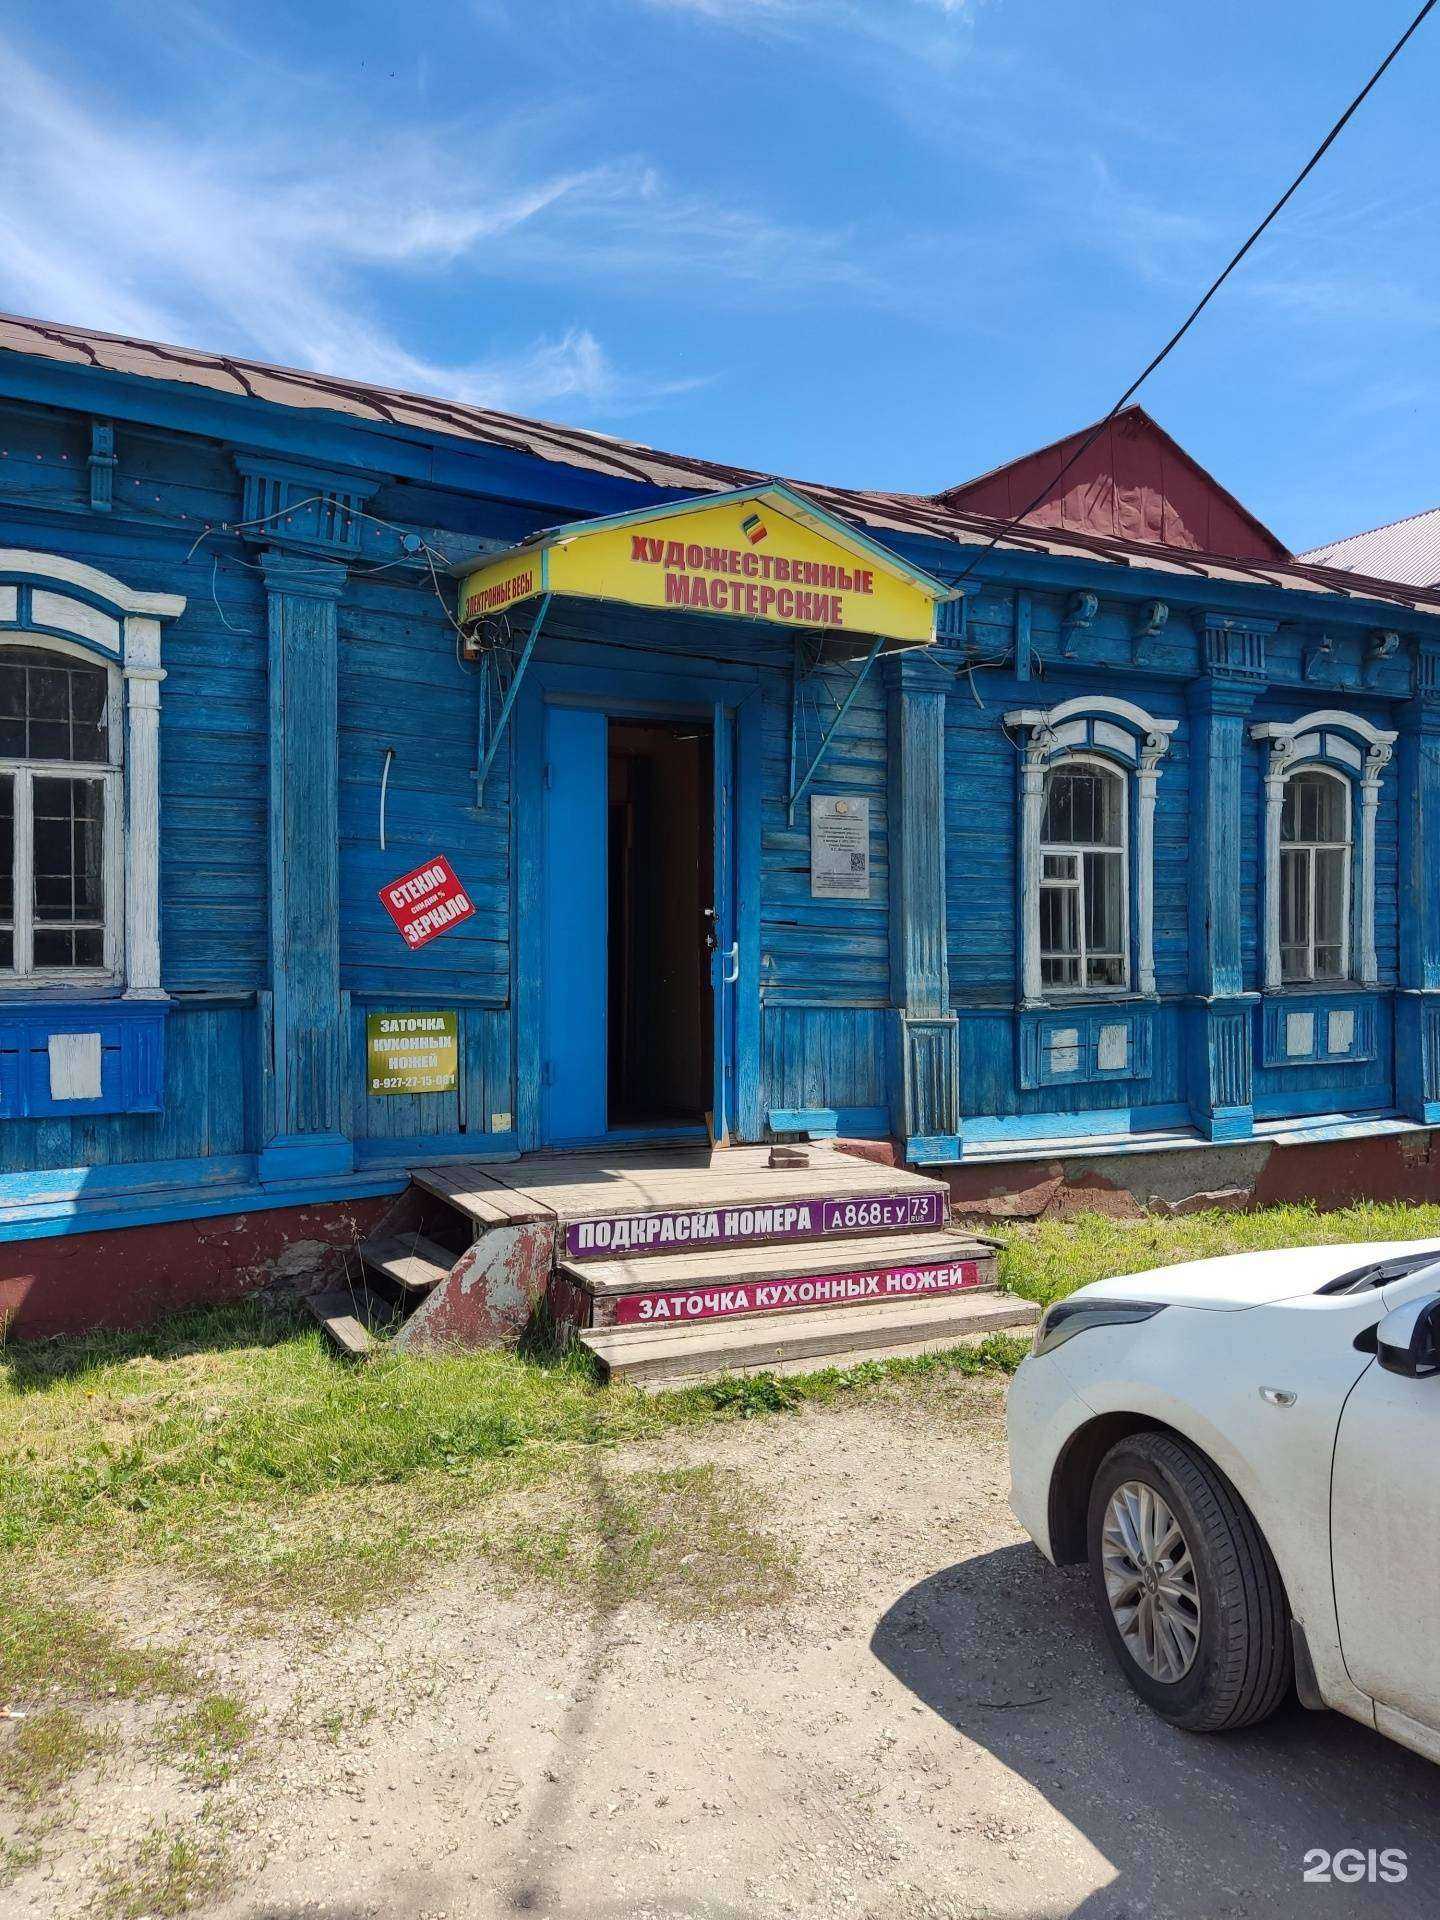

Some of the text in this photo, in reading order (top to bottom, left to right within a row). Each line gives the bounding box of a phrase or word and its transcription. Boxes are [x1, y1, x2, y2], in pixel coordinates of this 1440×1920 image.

[631, 535, 874, 595] ХУДОЖЕСТВЕННЫЕ
[465, 570, 533, 618] ЭЛЕКТРОННЫЕ ВЕСЫ
[665, 572, 843, 625] МАСТЕРСКИЕ
[389, 865, 447, 909] СТЕКЛО
[403, 893, 470, 943] ЗЕРКАЛО
[373, 1036, 452, 1052] КУХОННЫХ
[380, 1018, 446, 1032] ЗАТОЧКА
[388, 1053, 438, 1070] НОЖЕЙ
[578, 1213, 720, 1249] ПОДКРАСКА
[724, 1206, 812, 1236] НОМЕРА
[911, 1198, 929, 1215] 73
[638, 1264, 963, 1320] ЗАТОЧКА КУХОННЫХ НОЖЕЙ
